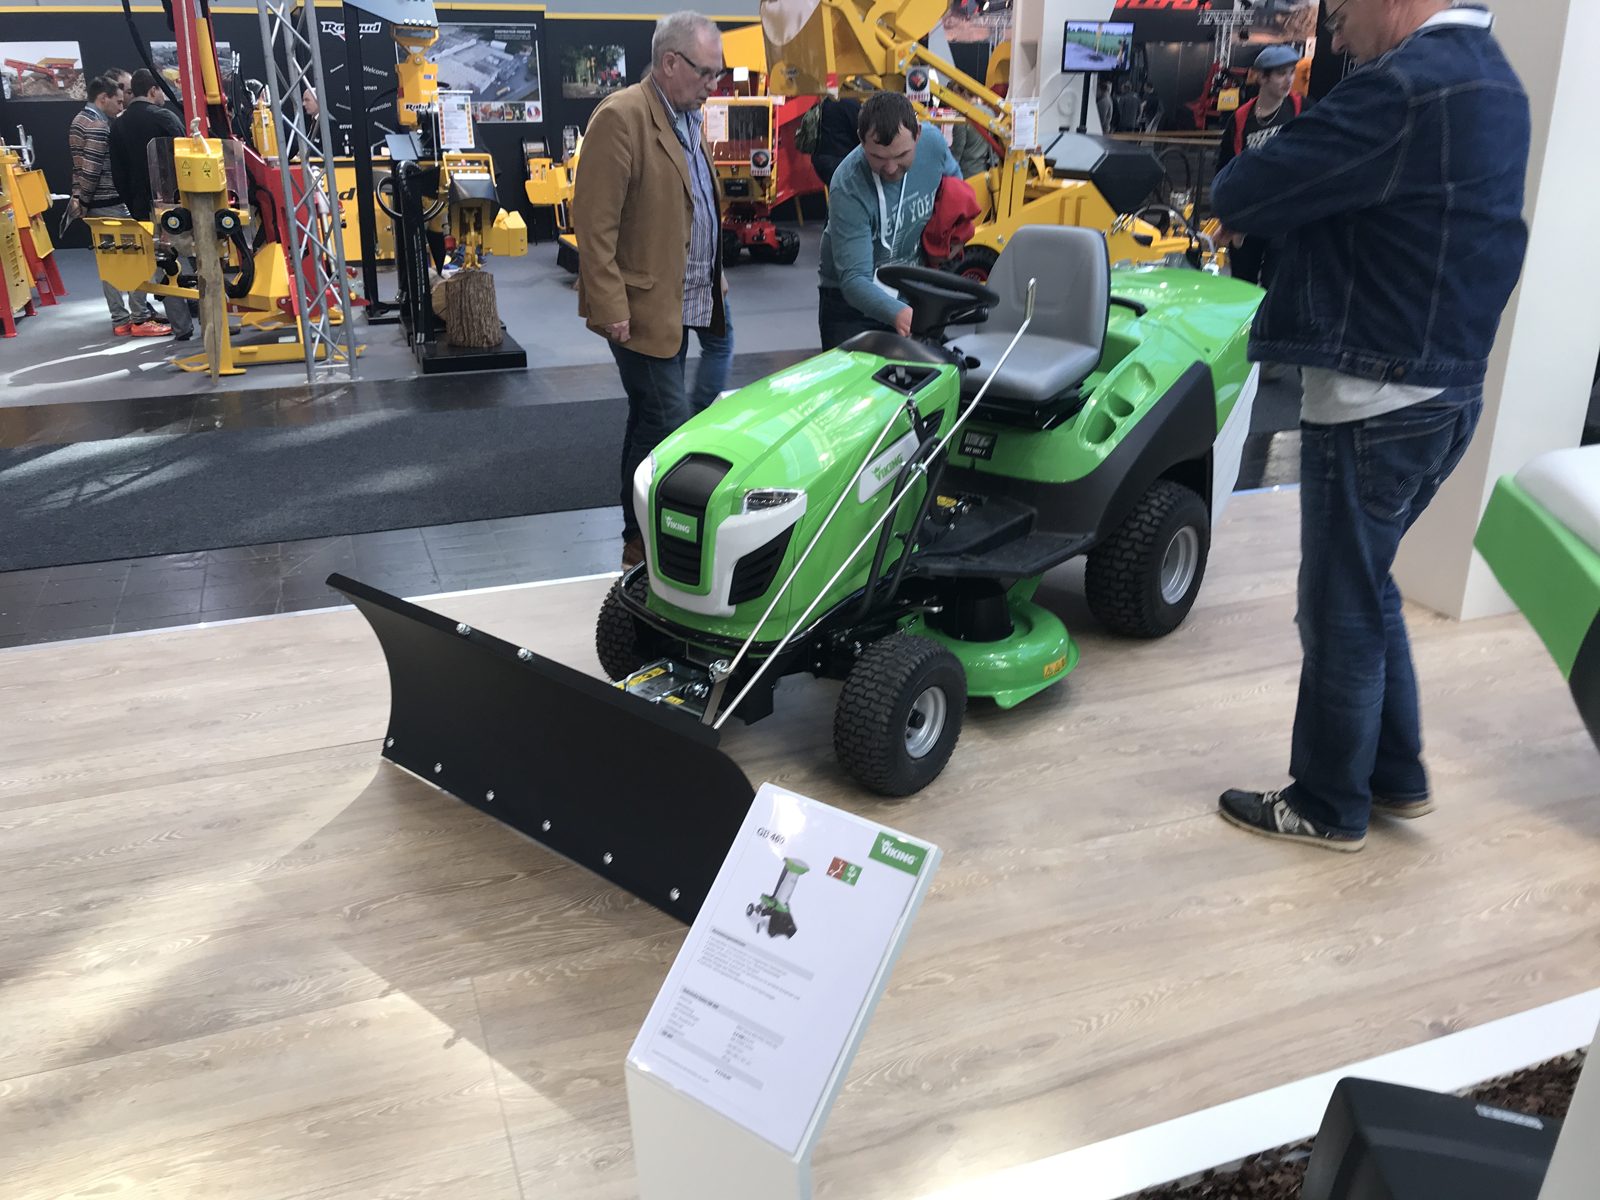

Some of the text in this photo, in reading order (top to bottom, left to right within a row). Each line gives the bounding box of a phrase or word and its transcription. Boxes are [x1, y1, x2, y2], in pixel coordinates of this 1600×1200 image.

[320, 21, 382, 37] Raud
[362, 64, 389, 78] Welcome
[664, 514, 691, 535] VIKING
[880, 837, 917, 866] VIKING
